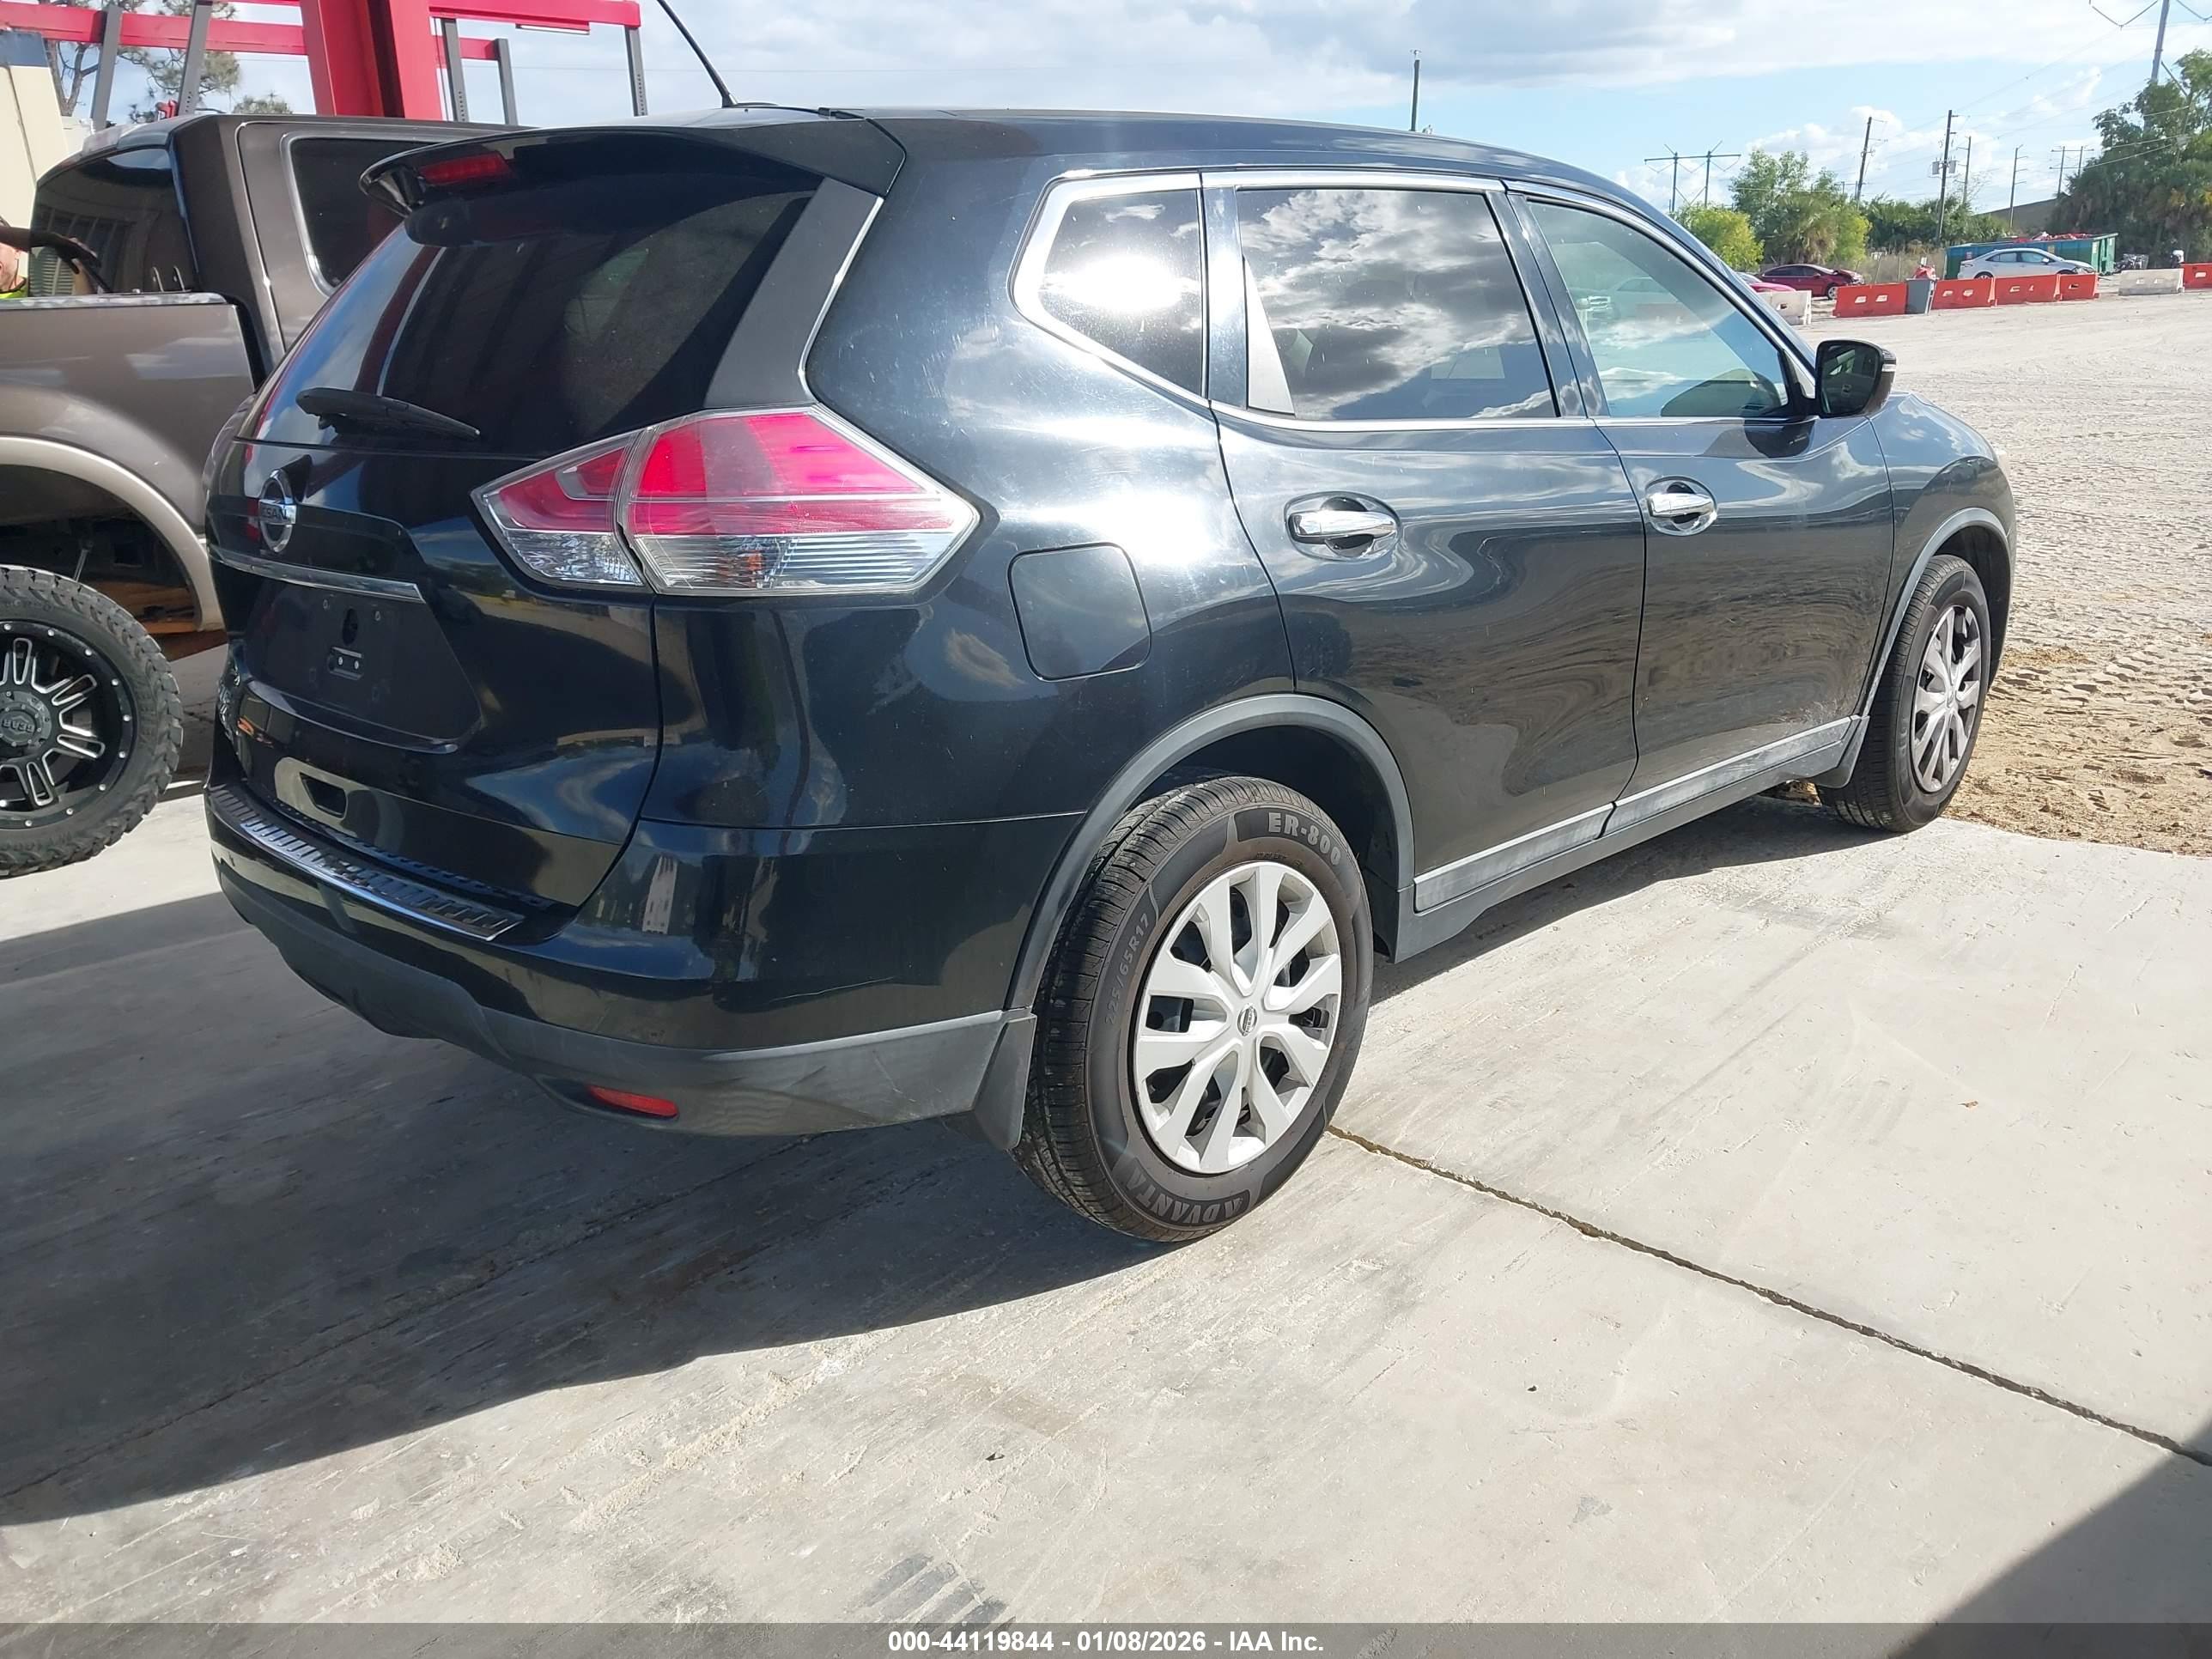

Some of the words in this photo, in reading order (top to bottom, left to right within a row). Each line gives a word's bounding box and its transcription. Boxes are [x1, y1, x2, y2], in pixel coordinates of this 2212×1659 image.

[1268, 811, 1341, 866] ER-800
[1105, 913, 1149, 1024] 225/65R17
[1126, 1167, 1243, 1224] ADVANTA
